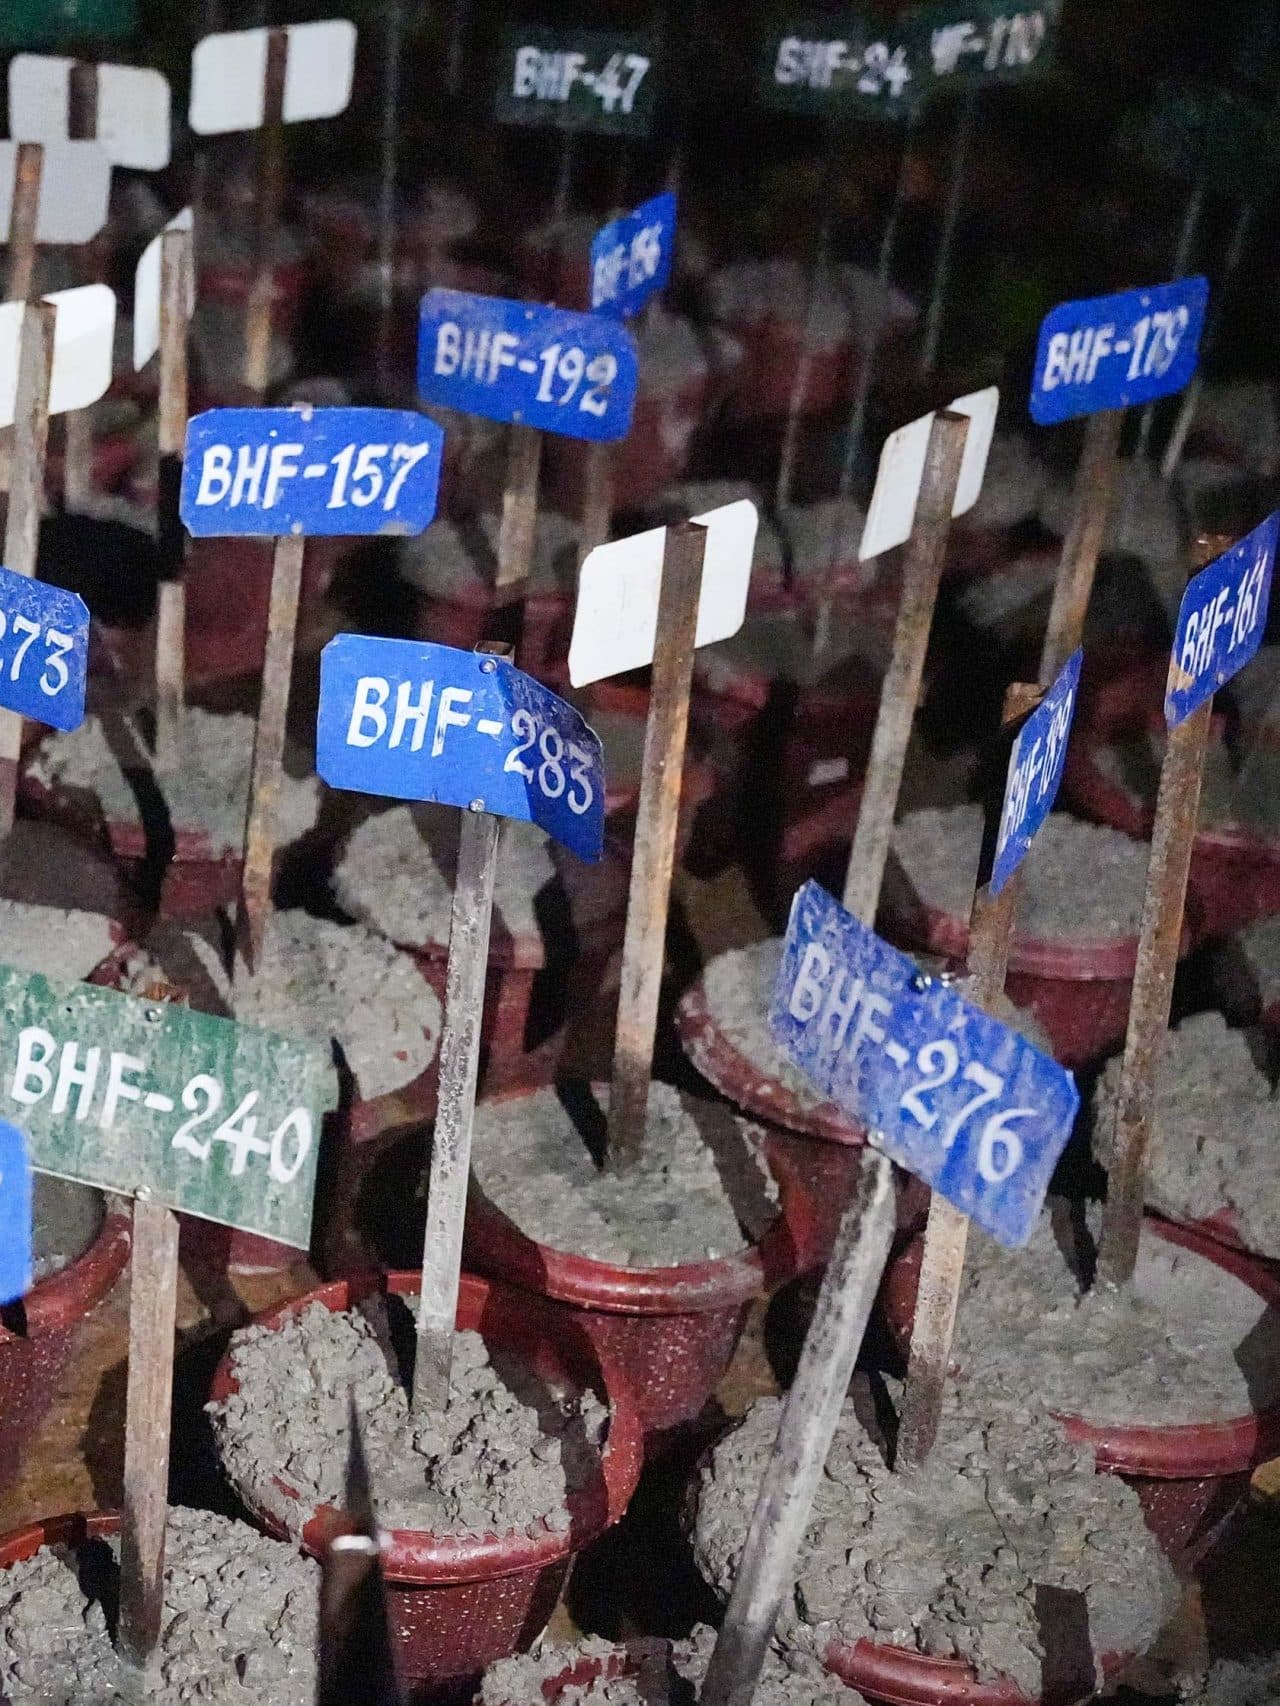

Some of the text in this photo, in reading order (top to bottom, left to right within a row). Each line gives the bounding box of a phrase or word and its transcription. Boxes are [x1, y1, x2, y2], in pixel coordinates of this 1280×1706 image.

[514, 46, 650, 114] BHF-47
[434, 321, 619, 416] BHF-192
[195, 441, 430, 512] BHF-157
[346, 676, 594, 815] BHF-283
[11, 1025, 312, 1184] BHF-240
[789, 942, 1039, 1184] BHF-276
